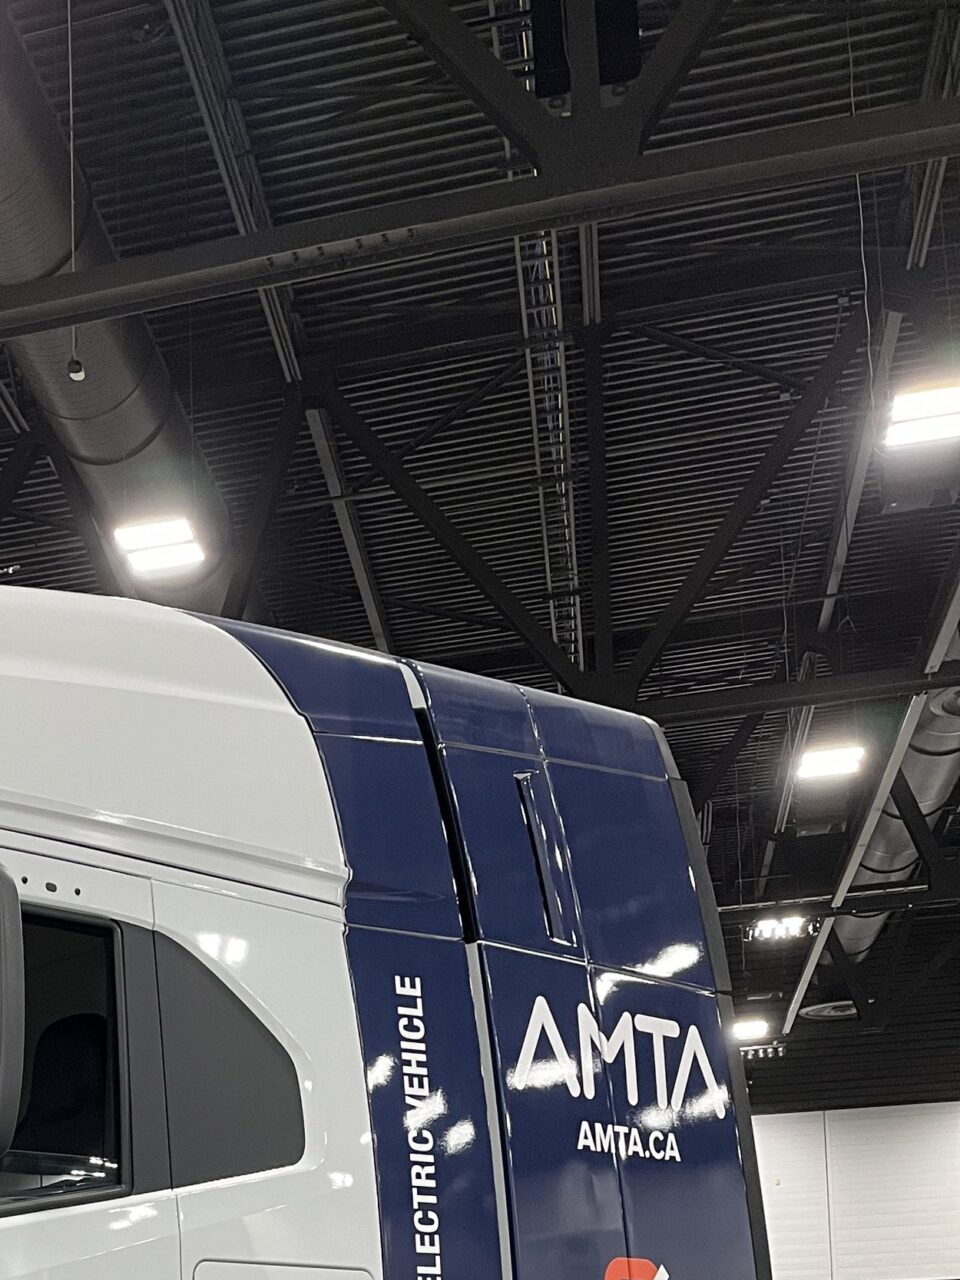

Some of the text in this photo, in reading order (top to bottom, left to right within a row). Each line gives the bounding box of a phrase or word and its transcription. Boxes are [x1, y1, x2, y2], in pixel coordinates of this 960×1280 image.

[394, 974, 432, 1125] VEHICLE
[513, 995, 727, 1120] AMTA
[577, 1120, 682, 1162] AMTA.CA
